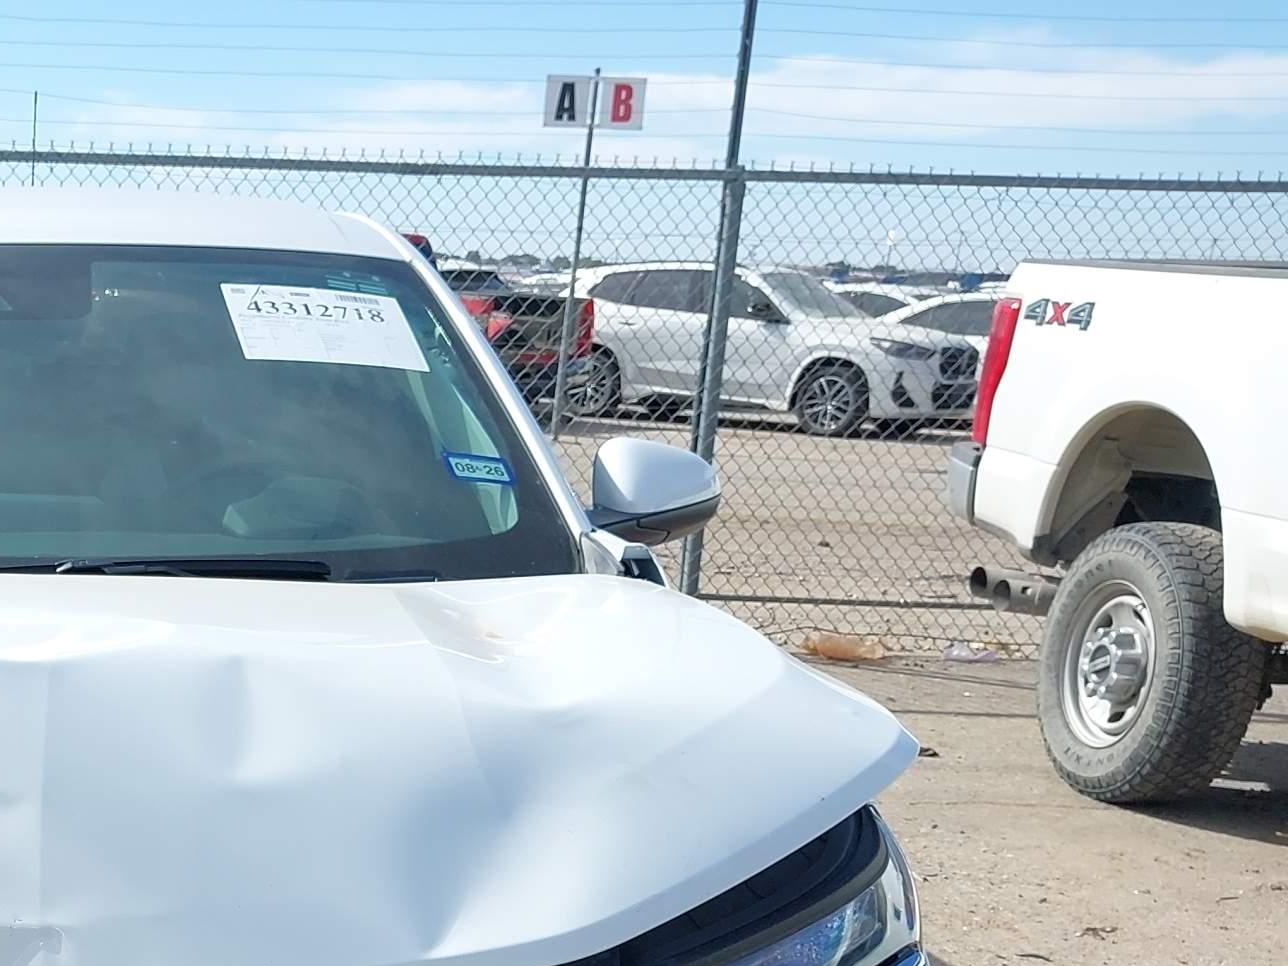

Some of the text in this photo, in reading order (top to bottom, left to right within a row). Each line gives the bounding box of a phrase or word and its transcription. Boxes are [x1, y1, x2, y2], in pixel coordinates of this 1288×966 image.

[554, 81, 576, 122] A
[610, 83, 633, 123] B
[246, 299, 386, 324] 43312718
